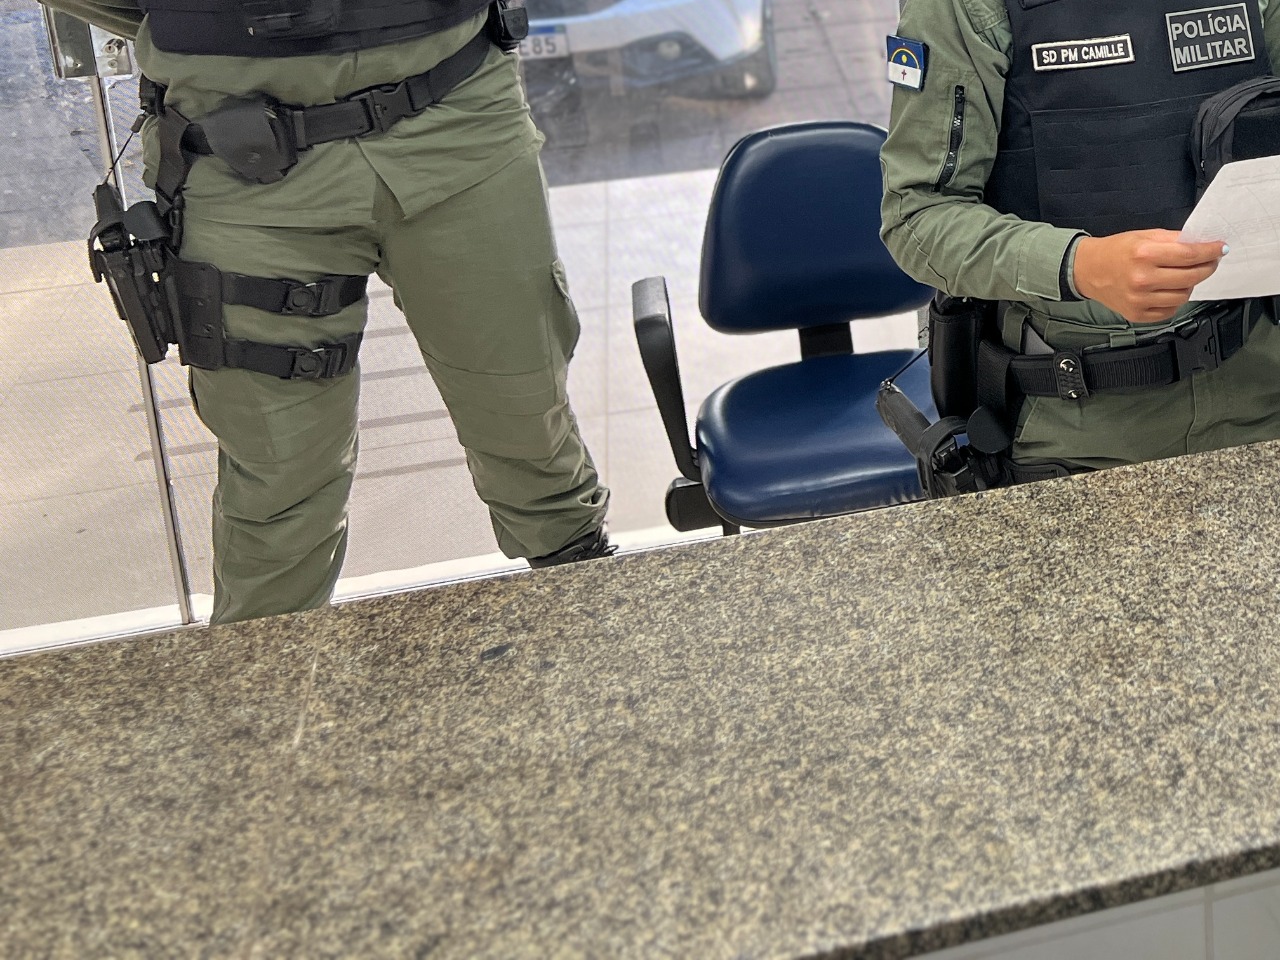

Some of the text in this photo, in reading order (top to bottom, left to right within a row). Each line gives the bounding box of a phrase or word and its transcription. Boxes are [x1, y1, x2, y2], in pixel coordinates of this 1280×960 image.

[1171, 14, 1246, 40] POLÍCIA
[1042, 43, 1125, 64] SD PM CAMILLE
[1175, 37, 1249, 65] MILITAR
